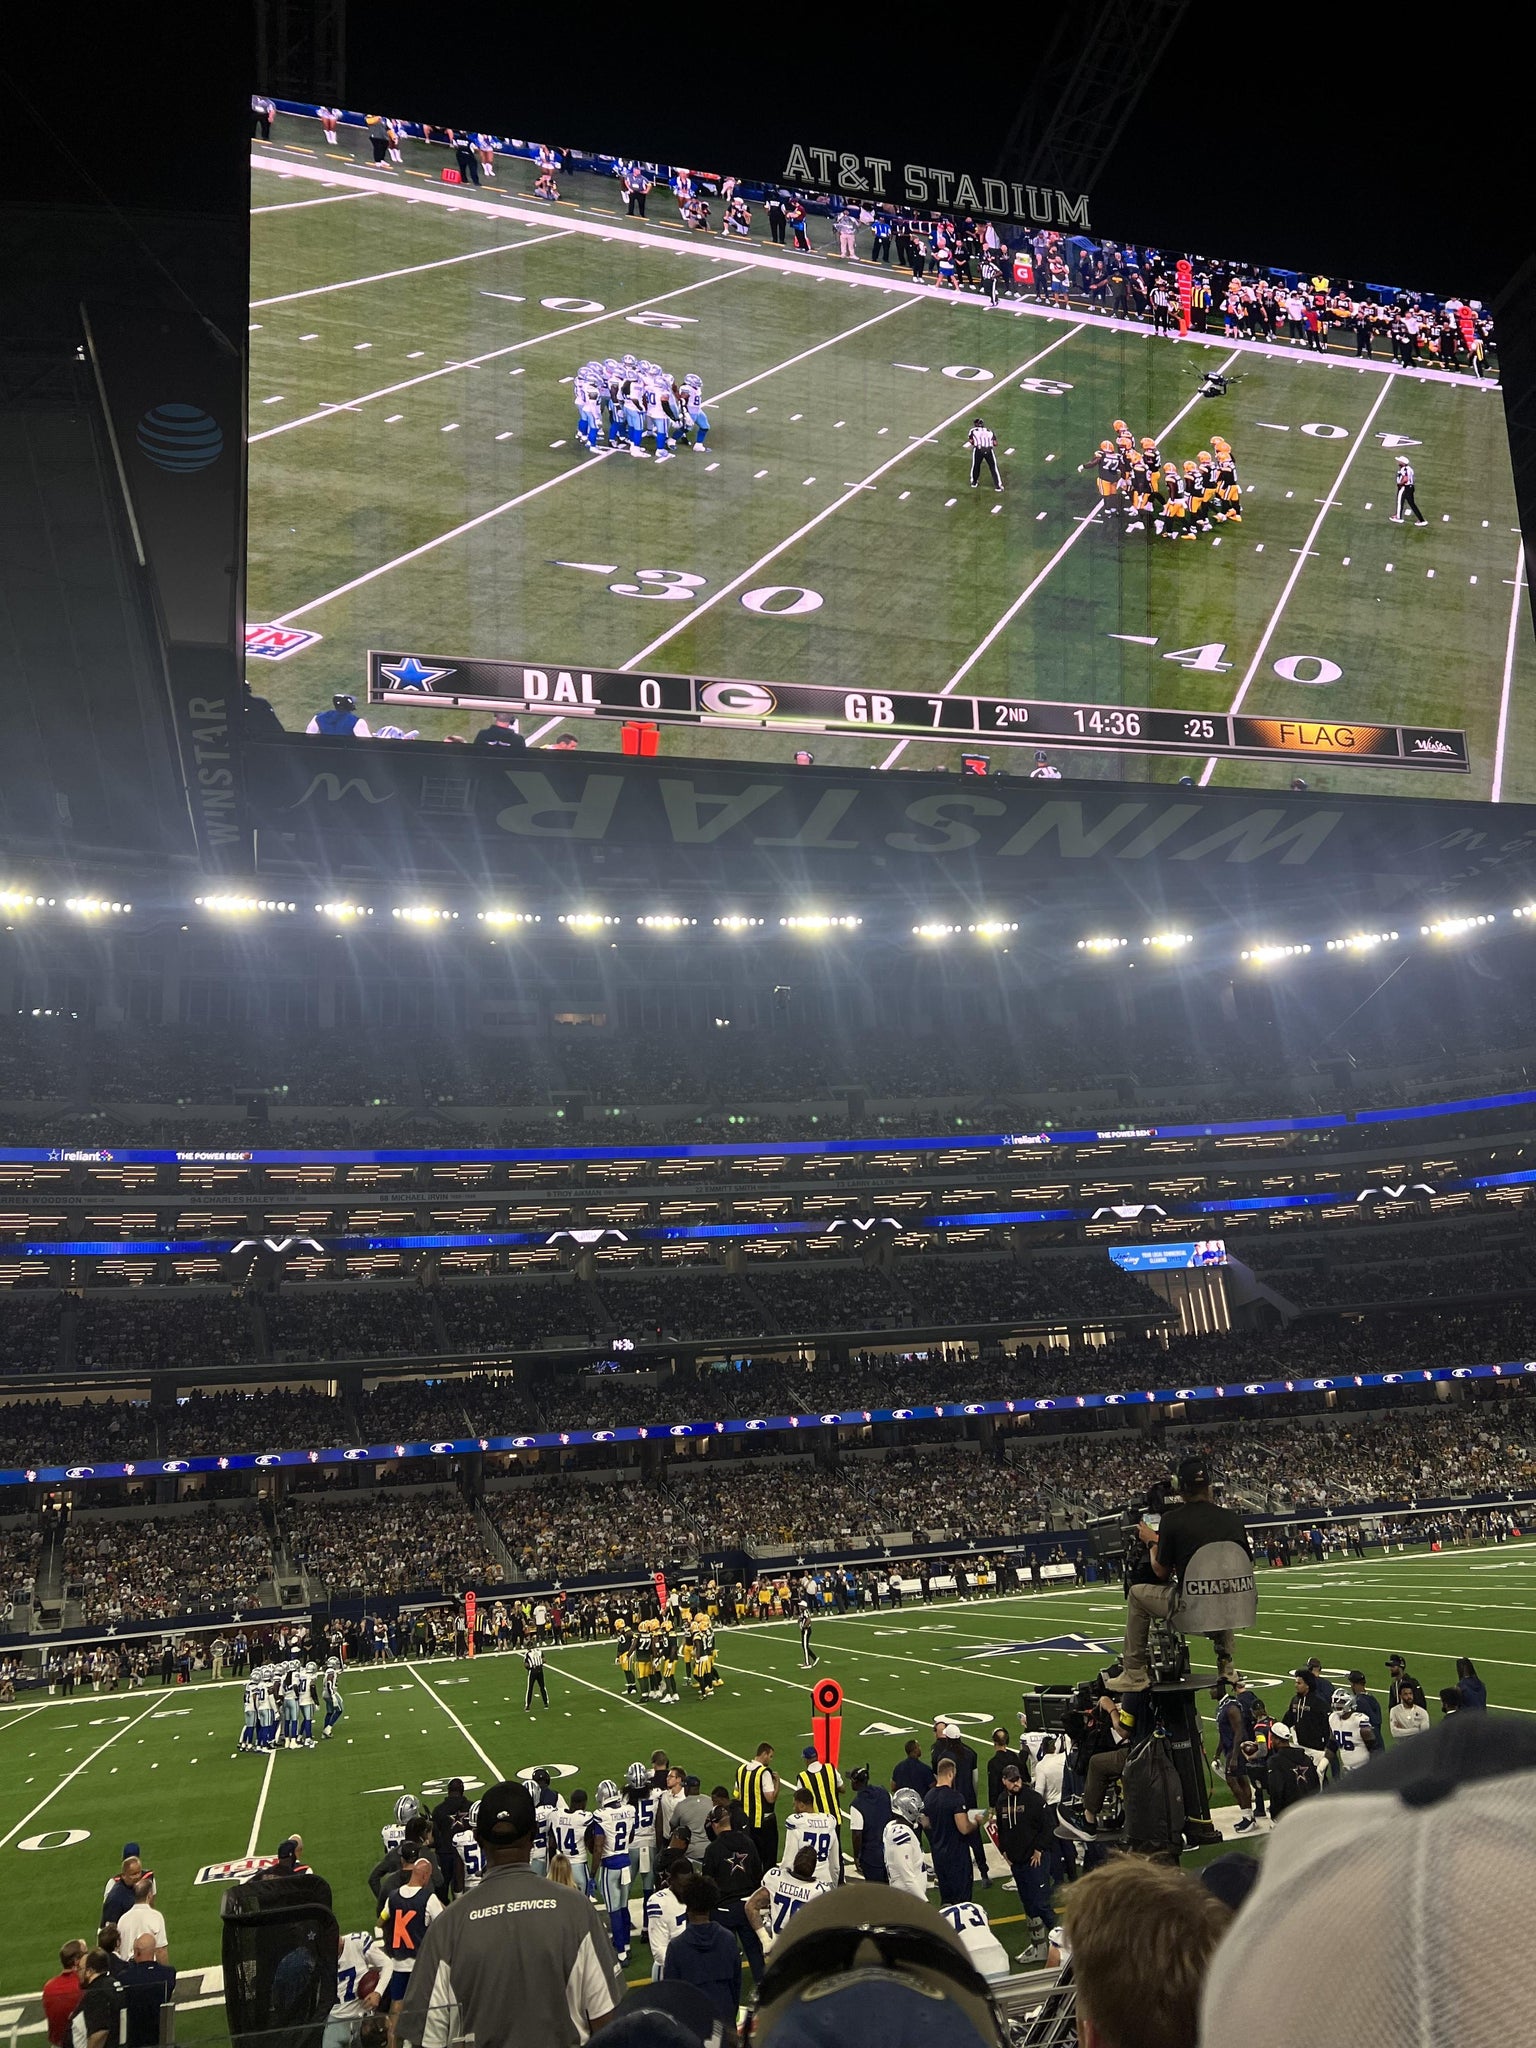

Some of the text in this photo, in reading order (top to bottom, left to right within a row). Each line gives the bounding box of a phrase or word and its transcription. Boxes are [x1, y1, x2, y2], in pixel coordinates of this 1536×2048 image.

[783, 144, 1092, 231] AT&T STADIUM
[1102, 457, 1120, 471] 77
[524, 669, 661, 709] DAL 0
[701, 683, 774, 716] G
[844, 694, 895, 725] GB
[927, 700, 943, 728] 7
[995, 705, 1029, 727] 2ND
[1073, 709, 1141, 737] 14:36
[1184, 719, 1214, 740] :25
[1280, 723, 1356, 748] FLAG
[190, 697, 240, 845] WINSTAR
[496, 771, 1344, 865] WINSTAR
[1014, 1134, 1041, 1145] reliant
[1097, 1131, 1111, 1139] THE
[1111, 1130, 1136, 1138] POWER
[64, 1150, 101, 1162] reliant
[176, 1152, 194, 1160] THE
[194, 1152, 225, 1160] POWER
[391, 1193, 426, 1202] MICHAEL
[427, 1192, 449, 1201] IRVIN
[572, 1189, 602, 1197] AIKMAN
[704, 1185, 733, 1193] EMMITT
[734, 1184, 756, 1192] SMITH
[203, 1196, 246, 1204] CHARLES
[246, 1196, 274, 1204] HALEY
[612, 1338, 635, 1351] 14:36
[1187, 1576, 1254, 1595] CHAPMAN
[639, 1638, 652, 1650] 77
[610, 1811, 631, 1821] THOMAS
[807, 1819, 829, 1829] STEELE
[556, 1827, 580, 1856] 14
[614, 1821, 627, 1851] 2
[803, 1832, 831, 1862] 78
[778, 1881, 811, 1901] KEEGAN
[469, 1899, 557, 1921] GUEST SERVICES
[940, 1902, 986, 1934] 73
[392, 1909, 417, 1950] K
